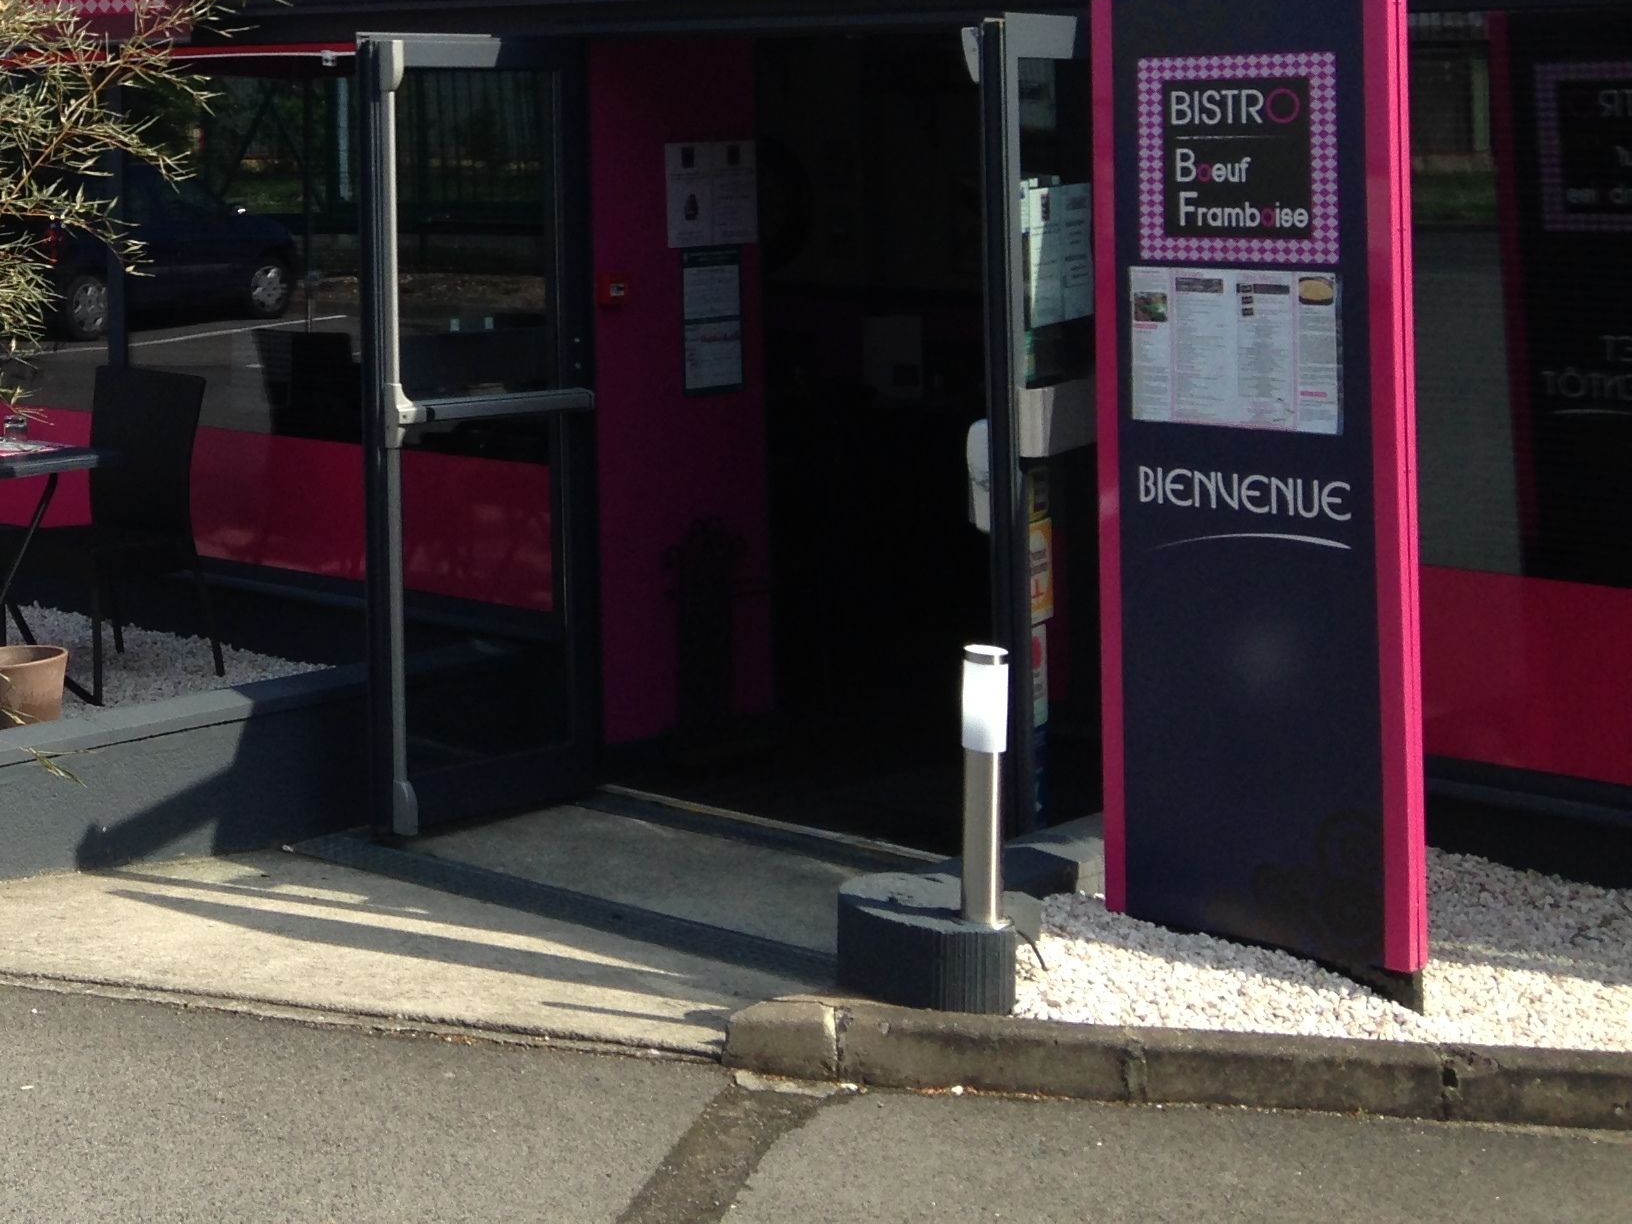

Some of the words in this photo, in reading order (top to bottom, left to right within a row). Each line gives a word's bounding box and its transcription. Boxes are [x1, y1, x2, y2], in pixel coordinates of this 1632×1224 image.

[1170, 87, 1300, 125] BISTRO
[1175, 148, 1251, 183] Boeuf
[1179, 191, 1309, 228] Framboise
[1139, 465, 1351, 521] BIENVENUE
